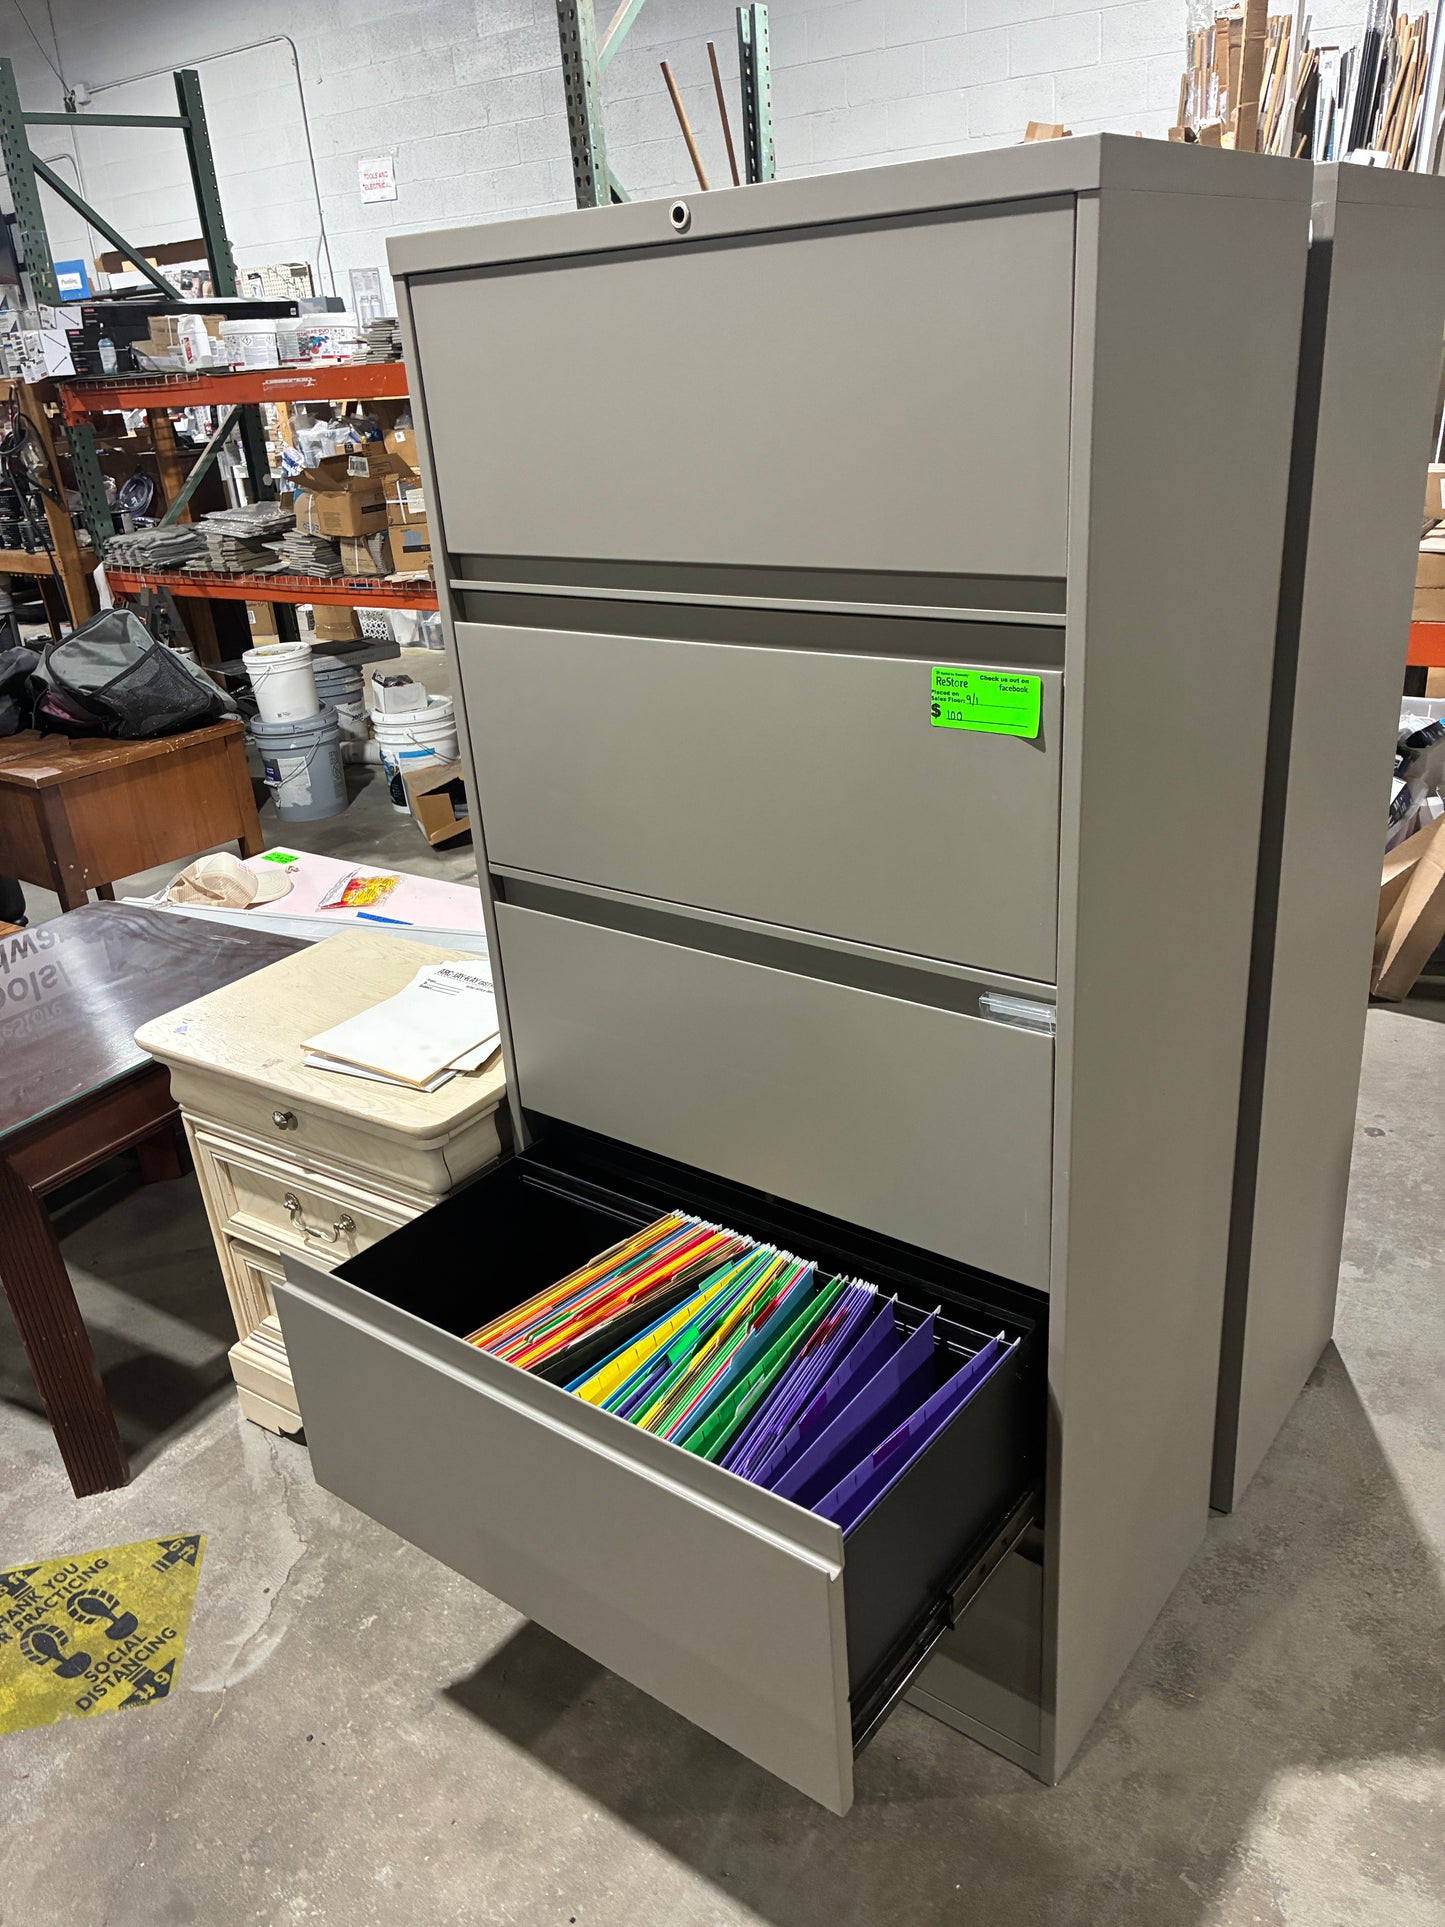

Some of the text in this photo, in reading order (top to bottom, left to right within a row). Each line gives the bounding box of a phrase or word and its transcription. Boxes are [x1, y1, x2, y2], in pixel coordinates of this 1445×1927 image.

[936, 676, 968, 688] ReStore
[999, 684, 1028, 693] facebook
[169, 1538, 186, 1551] 6
[43, 1563, 79, 1590] YOU
[13, 1558, 109, 1632] PRACTICING
[75, 1627, 177, 1711] DISTANCING
[84, 1633, 148, 1683] SOCIAL
